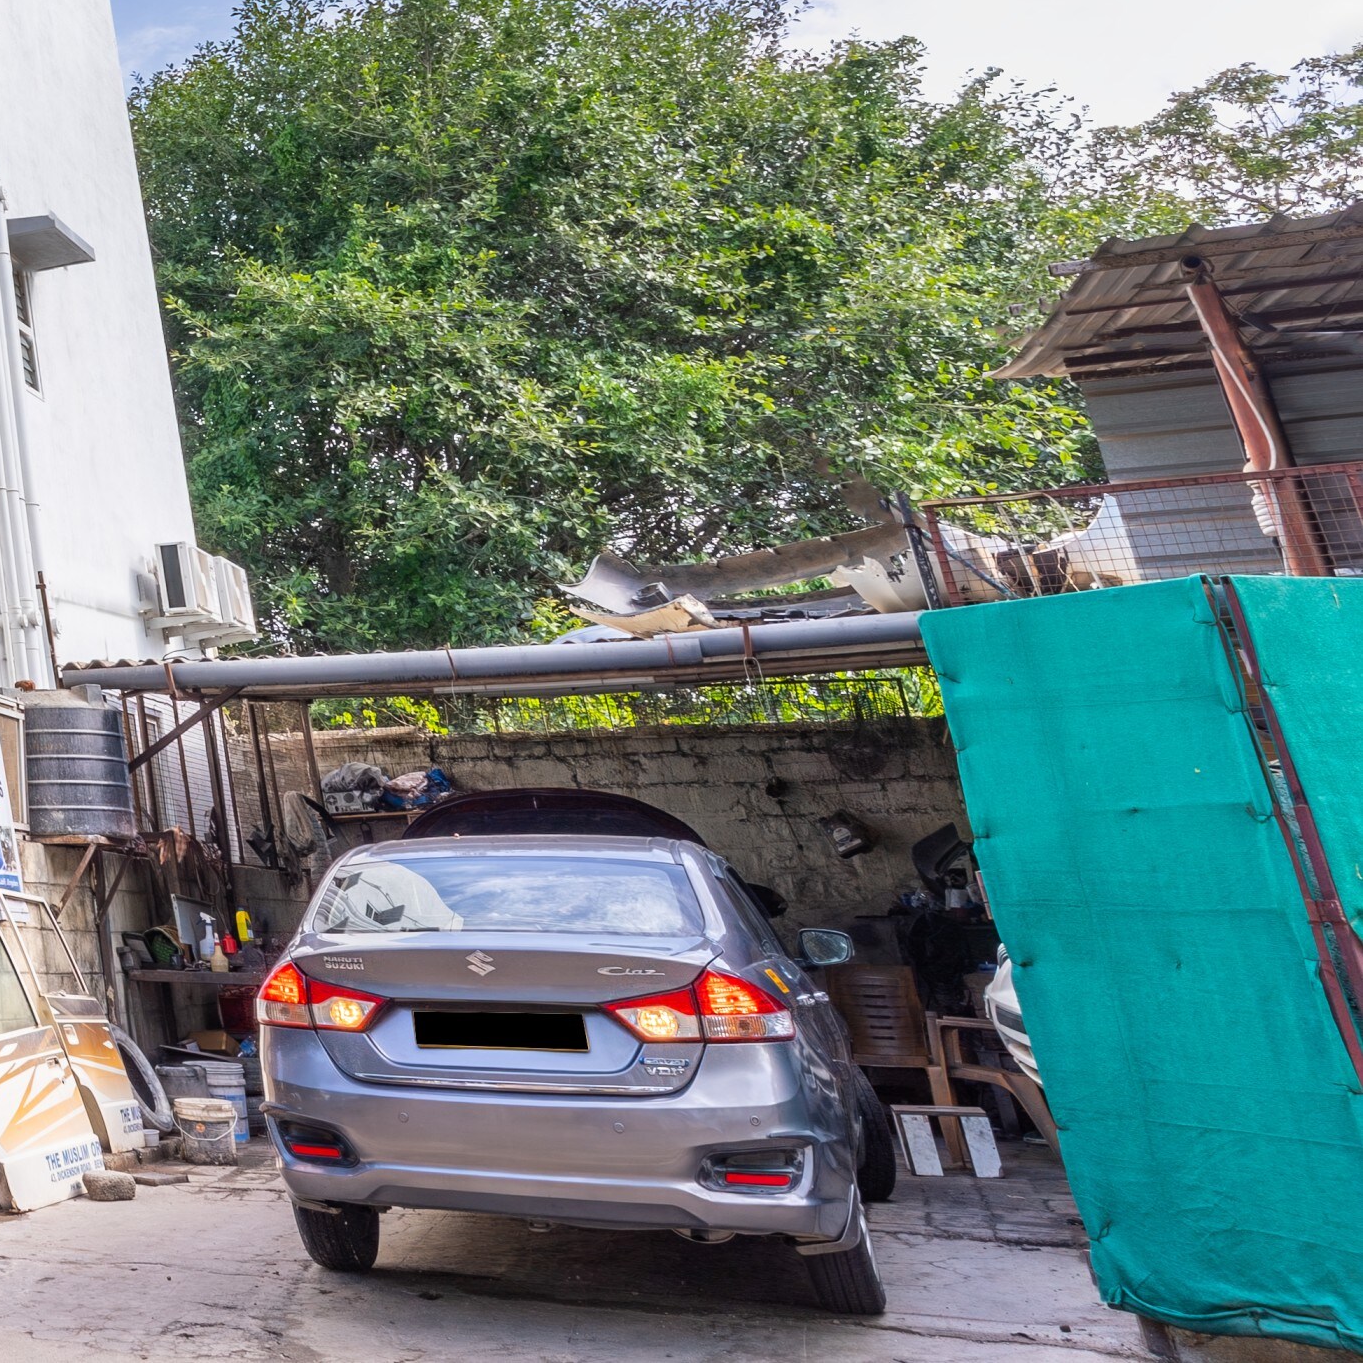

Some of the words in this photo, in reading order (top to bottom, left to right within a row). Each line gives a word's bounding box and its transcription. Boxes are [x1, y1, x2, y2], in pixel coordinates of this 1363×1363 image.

[325, 962, 365, 970] SUZUKI
[597, 966, 666, 976] Ciaz
[46, 1152, 62, 1171] THE
[62, 1143, 90, 1166] MUSLIM
